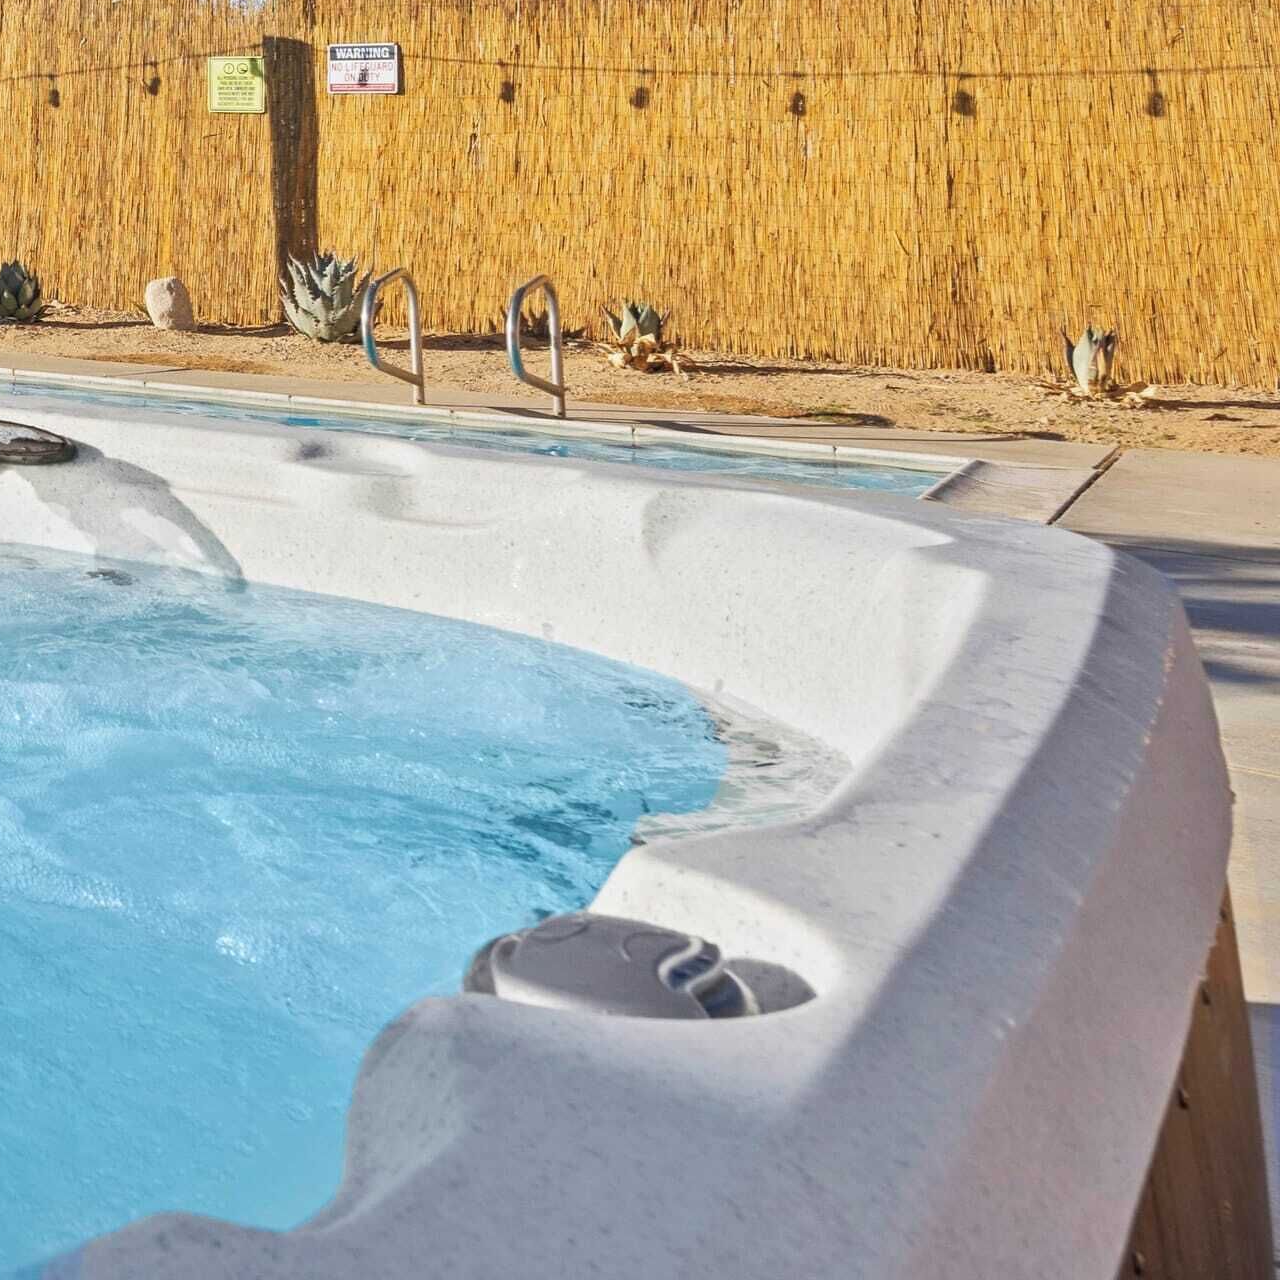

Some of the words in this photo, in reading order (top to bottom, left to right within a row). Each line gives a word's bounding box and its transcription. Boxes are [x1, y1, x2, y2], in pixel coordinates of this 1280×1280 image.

[335, 48, 390, 59] WARNING
[332, 62, 343, 72] NO
[345, 62, 393, 72] LIFEGUARD
[344, 73, 356, 82] ON
[359, 73, 381, 82] DUTY
